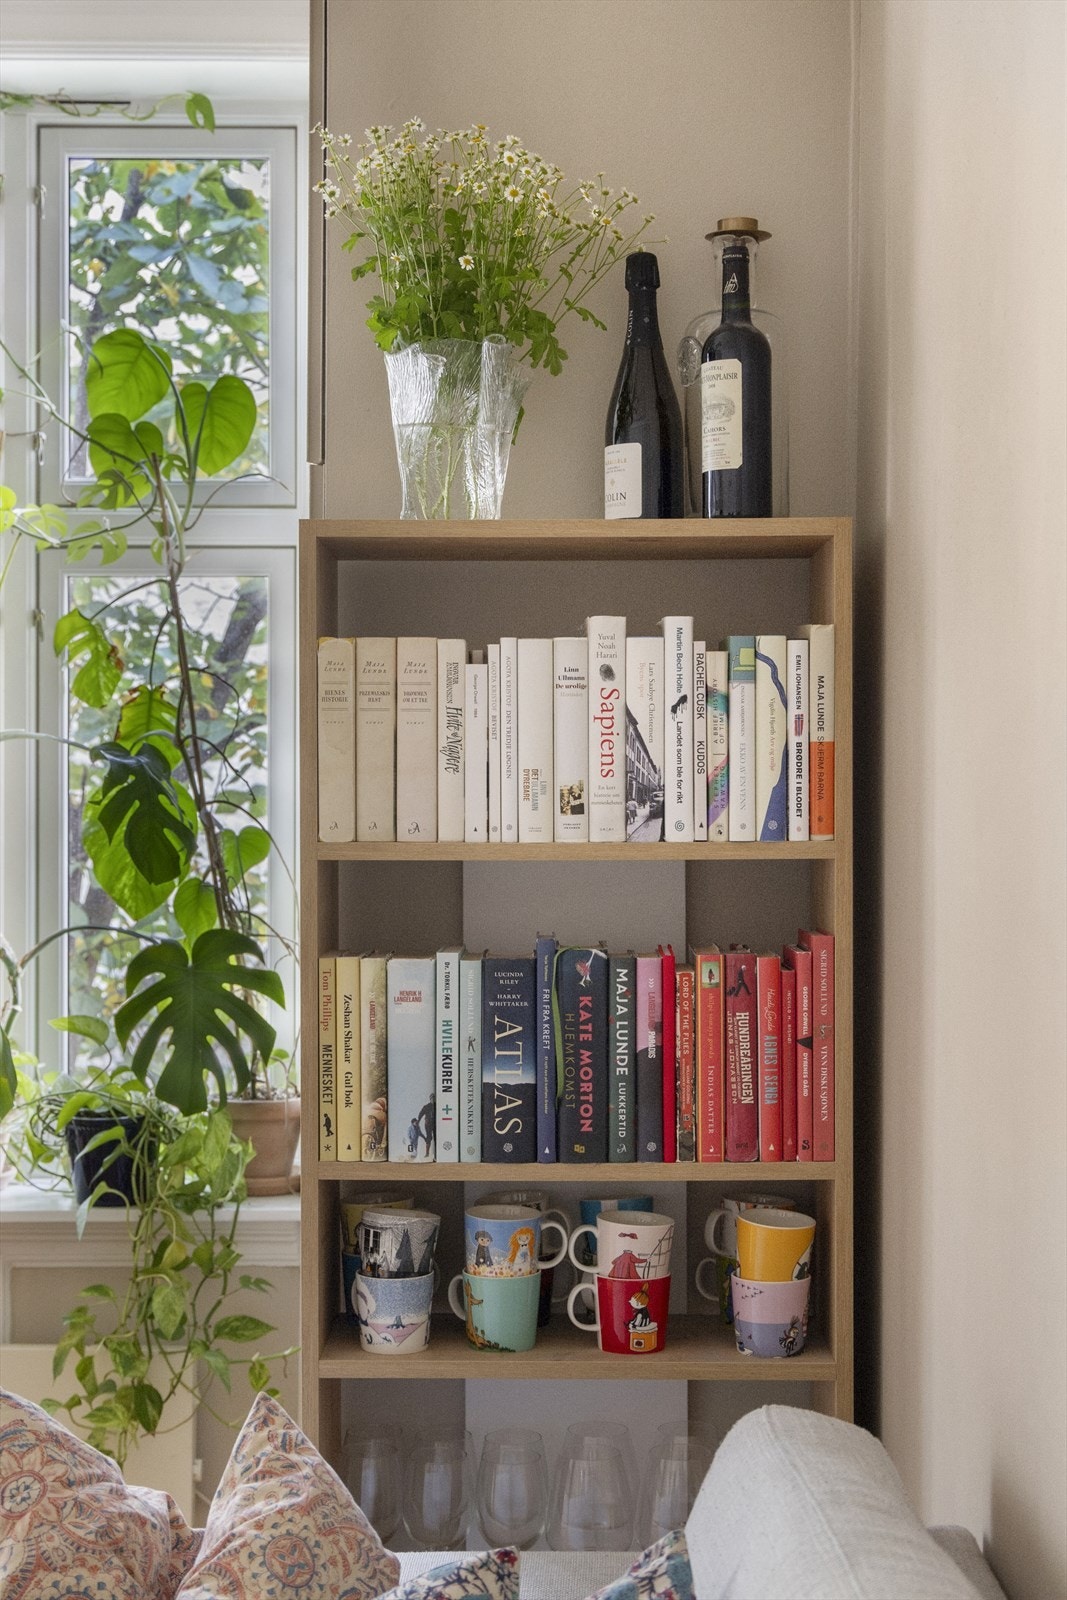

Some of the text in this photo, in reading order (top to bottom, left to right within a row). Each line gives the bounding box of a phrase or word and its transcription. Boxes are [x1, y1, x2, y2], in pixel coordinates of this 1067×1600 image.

[596, 651, 618, 659] Harari
[597, 633, 616, 641] Yuval
[676, 627, 684, 694] Martin Bech Holte
[647, 662, 656, 744] Lars Saabye Christensen
[817, 675, 825, 701] MAJA
[445, 705, 463, 732] Hvite
[696, 652, 706, 775] RACHEL CUSK KUDOS
[768, 716, 776, 736] Hjorth
[817, 702, 825, 732] LUNDE
[593, 687, 620, 778] Sapiens
[719, 734, 726, 744] OF
[676, 721, 684, 804] Landet som ble for rikt
[740, 766, 747, 774] AV
[795, 741, 803, 780] BRØDRE
[817, 735, 825, 769] SKJERM
[531, 768, 539, 781] DET
[740, 776, 747, 787] EN
[542, 988, 550, 1002] FRI
[616, 968, 628, 1016] MAJA
[682, 1000, 689, 1012] OF
[542, 1004, 550, 1022] FRA
[320, 968, 333, 1105] Tom Phillips MENNESKET
[343, 994, 353, 1108] Zeshan Shakar Gul bok
[542, 1023, 550, 1050] KREFT
[616, 1021, 628, 1076] LUNDE
[647, 1031, 656, 1059] PARADIS
[764, 1035, 778, 1065] AGNES
[820, 949, 828, 1122] SIGRID SOLLUND VINN DISKUSJONEN
[441, 1019, 453, 1093] HVILEKUREN
[564, 1013, 576, 1109] HJEMKOMST
[579, 996, 593, 1132] KATE MORTON
[735, 1011, 755, 1105] HUNDREÅRINGEN
[493, 1014, 523, 1135] ATLAS
[729, 1049, 738, 1105] JONASSON
[764, 1075, 778, 1105] SENGA
[618, 1082, 627, 1138] LUKKERTID
